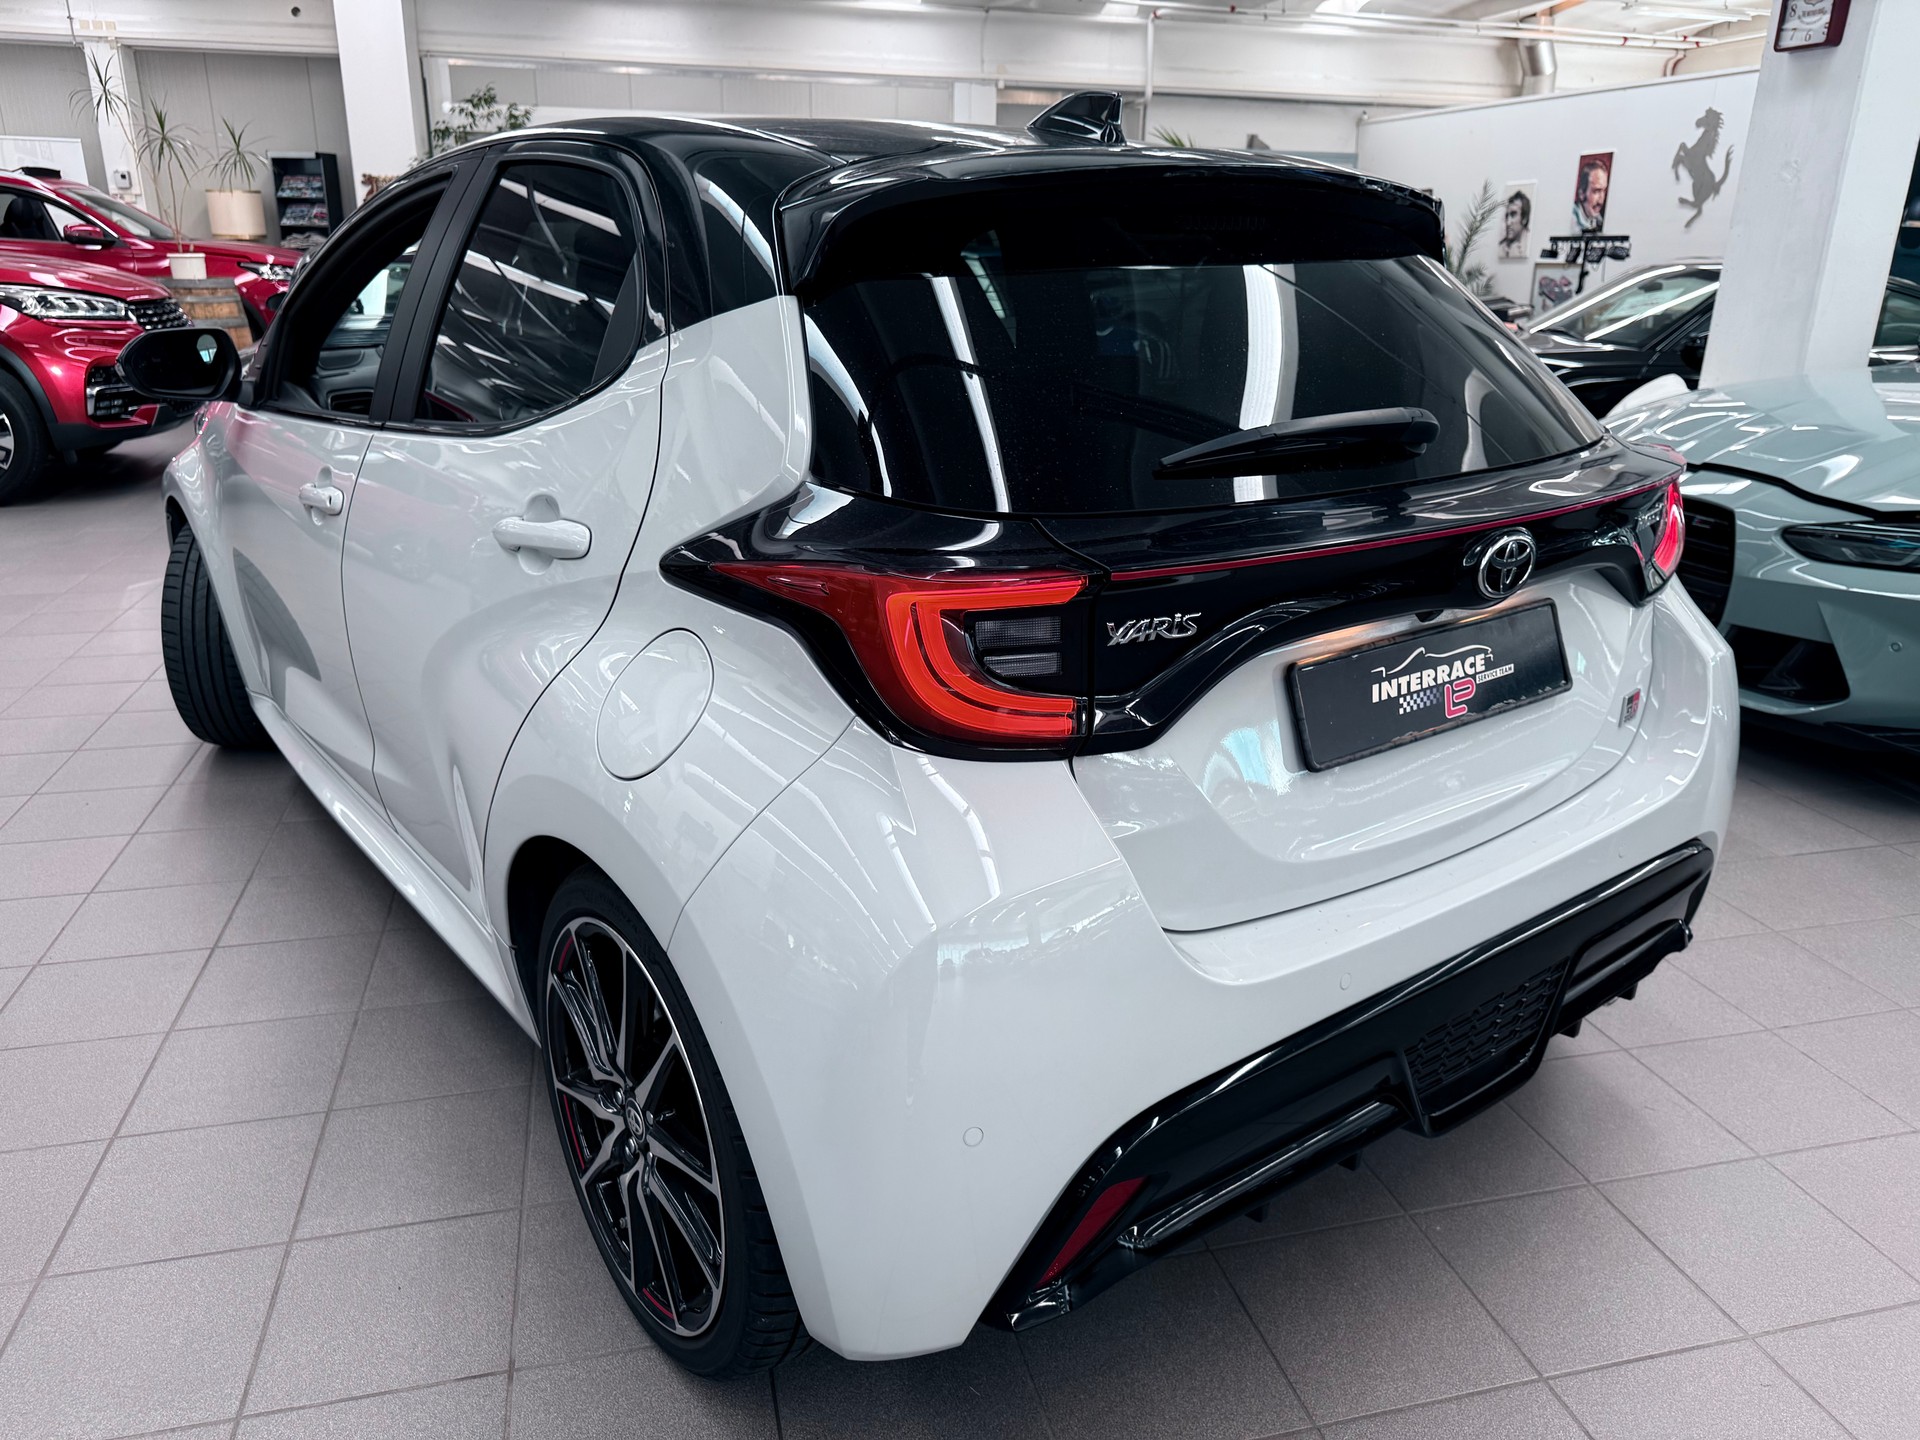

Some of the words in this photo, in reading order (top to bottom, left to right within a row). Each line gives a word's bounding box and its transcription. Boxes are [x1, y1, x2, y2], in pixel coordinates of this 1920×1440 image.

[1790, 3, 1798, 18] 8
[1804, 29, 1812, 42] 6
[1371, 653, 1486, 704] INTERRACE
[1477, 669, 1499, 683] SERVICE
[1498, 664, 1514, 676] TEAM
